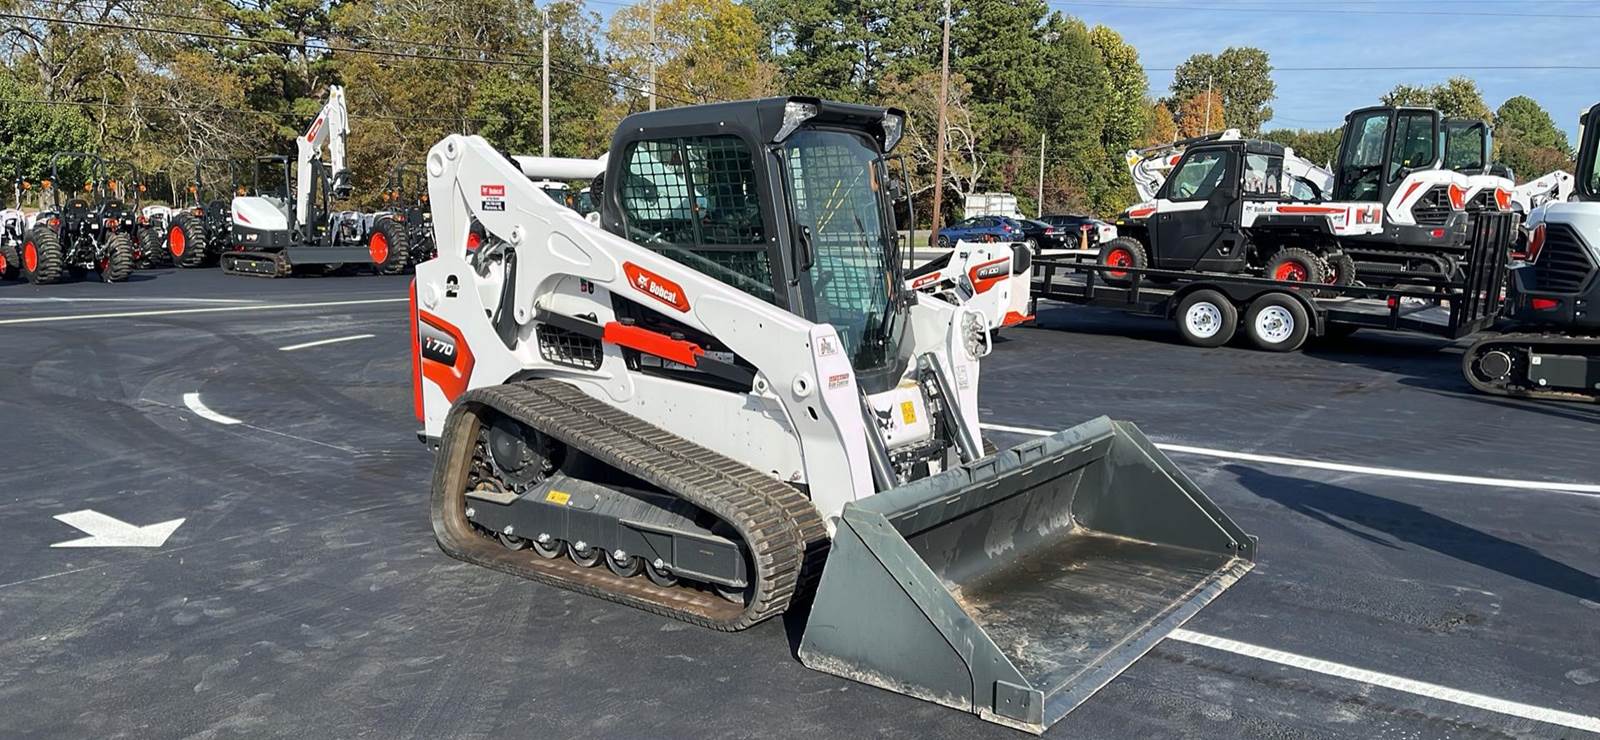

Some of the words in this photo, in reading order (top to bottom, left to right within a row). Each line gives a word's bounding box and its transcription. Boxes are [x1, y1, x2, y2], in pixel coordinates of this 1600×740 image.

[446, 274, 459, 298] 2
[649, 281, 677, 304] Bobcat
[426, 337, 454, 357] T770
